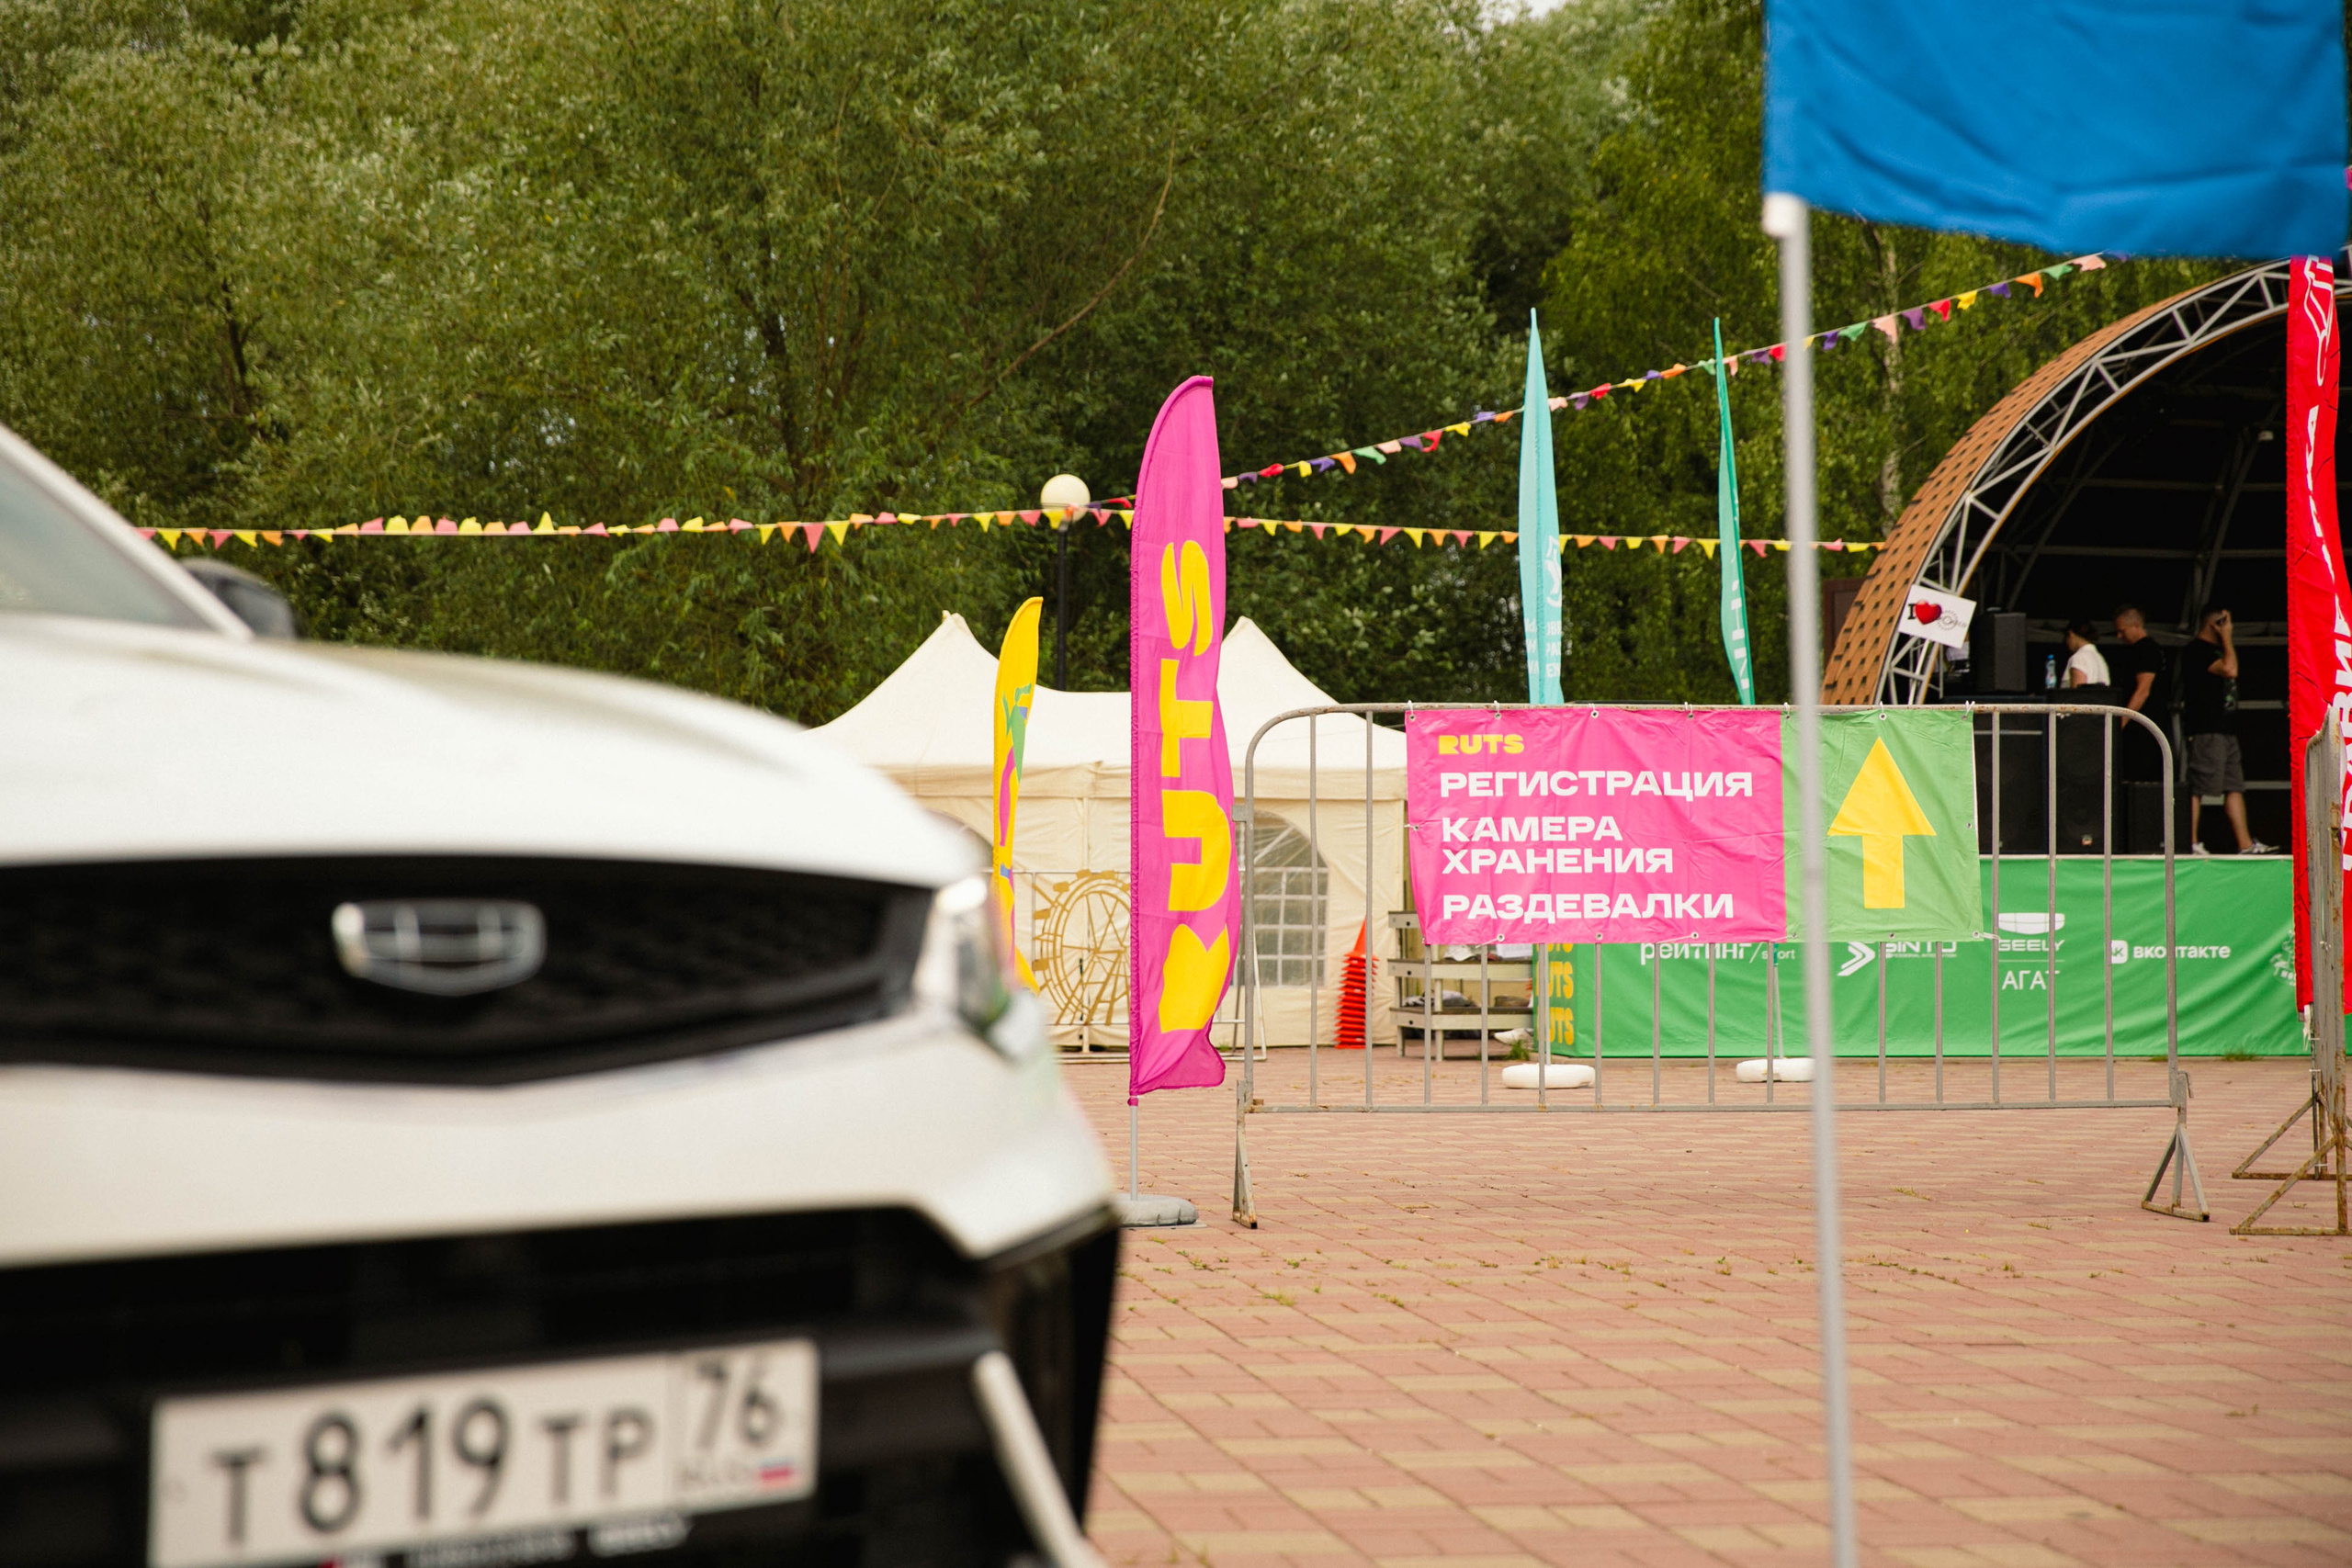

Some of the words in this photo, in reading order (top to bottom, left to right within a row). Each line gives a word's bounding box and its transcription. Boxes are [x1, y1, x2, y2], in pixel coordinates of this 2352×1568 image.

[1438, 734, 1523, 755] RUTS
[1159, 540, 1232, 1034] RUTS
[1440, 771, 1753, 803] РЕГИСТРАЦИЯ
[1442, 816, 1623, 842] КАМЕРА
[1442, 847, 1673, 874] ХРАНЕНИЯ
[1443, 893, 1734, 925] РАЗДЕВАЛКИ
[2132, 945, 2231, 959] вкотакте
[1535, 961, 1574, 999] UTS
